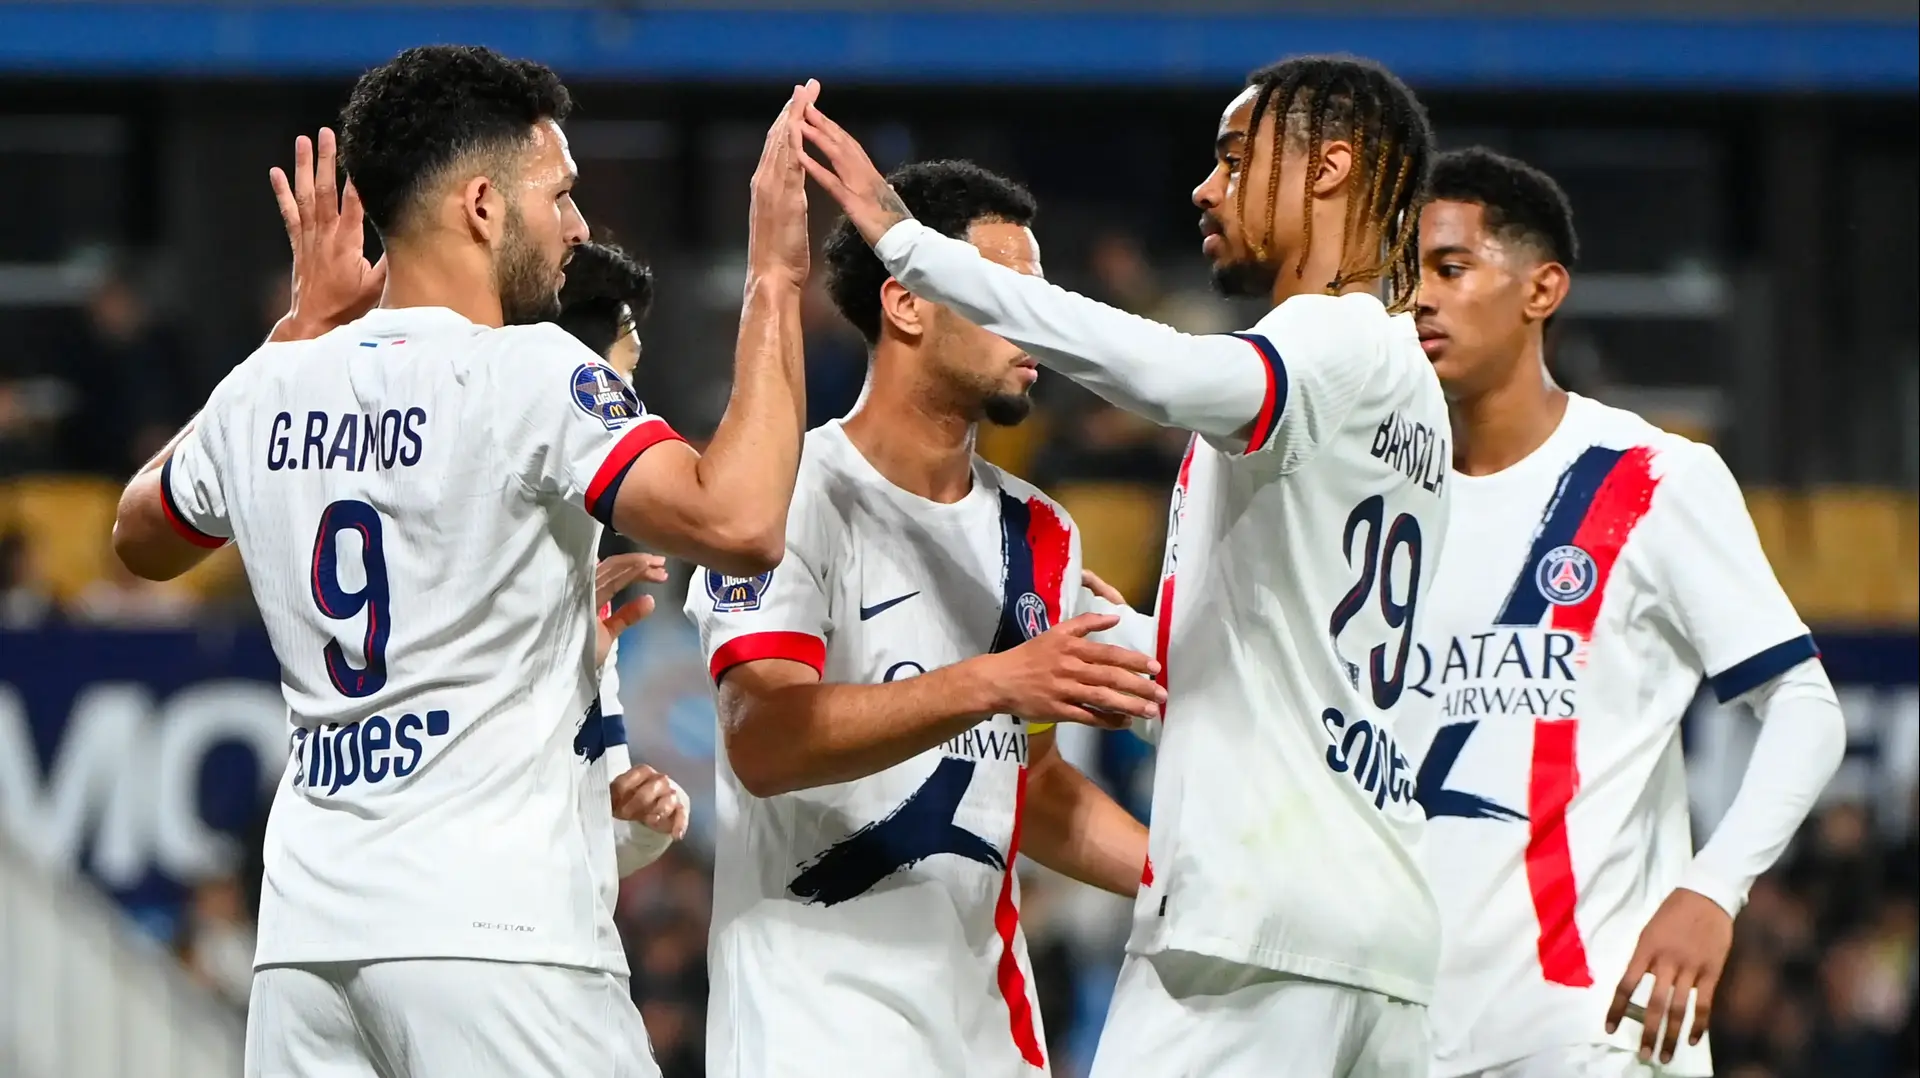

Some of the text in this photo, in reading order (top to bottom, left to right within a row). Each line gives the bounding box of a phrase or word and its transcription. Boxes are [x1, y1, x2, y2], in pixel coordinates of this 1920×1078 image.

[267, 406, 428, 473] G.RAMOS
[311, 499, 392, 698] 9
[1020, 595, 1043, 614] PARIS
[1329, 495, 1422, 710] 29
